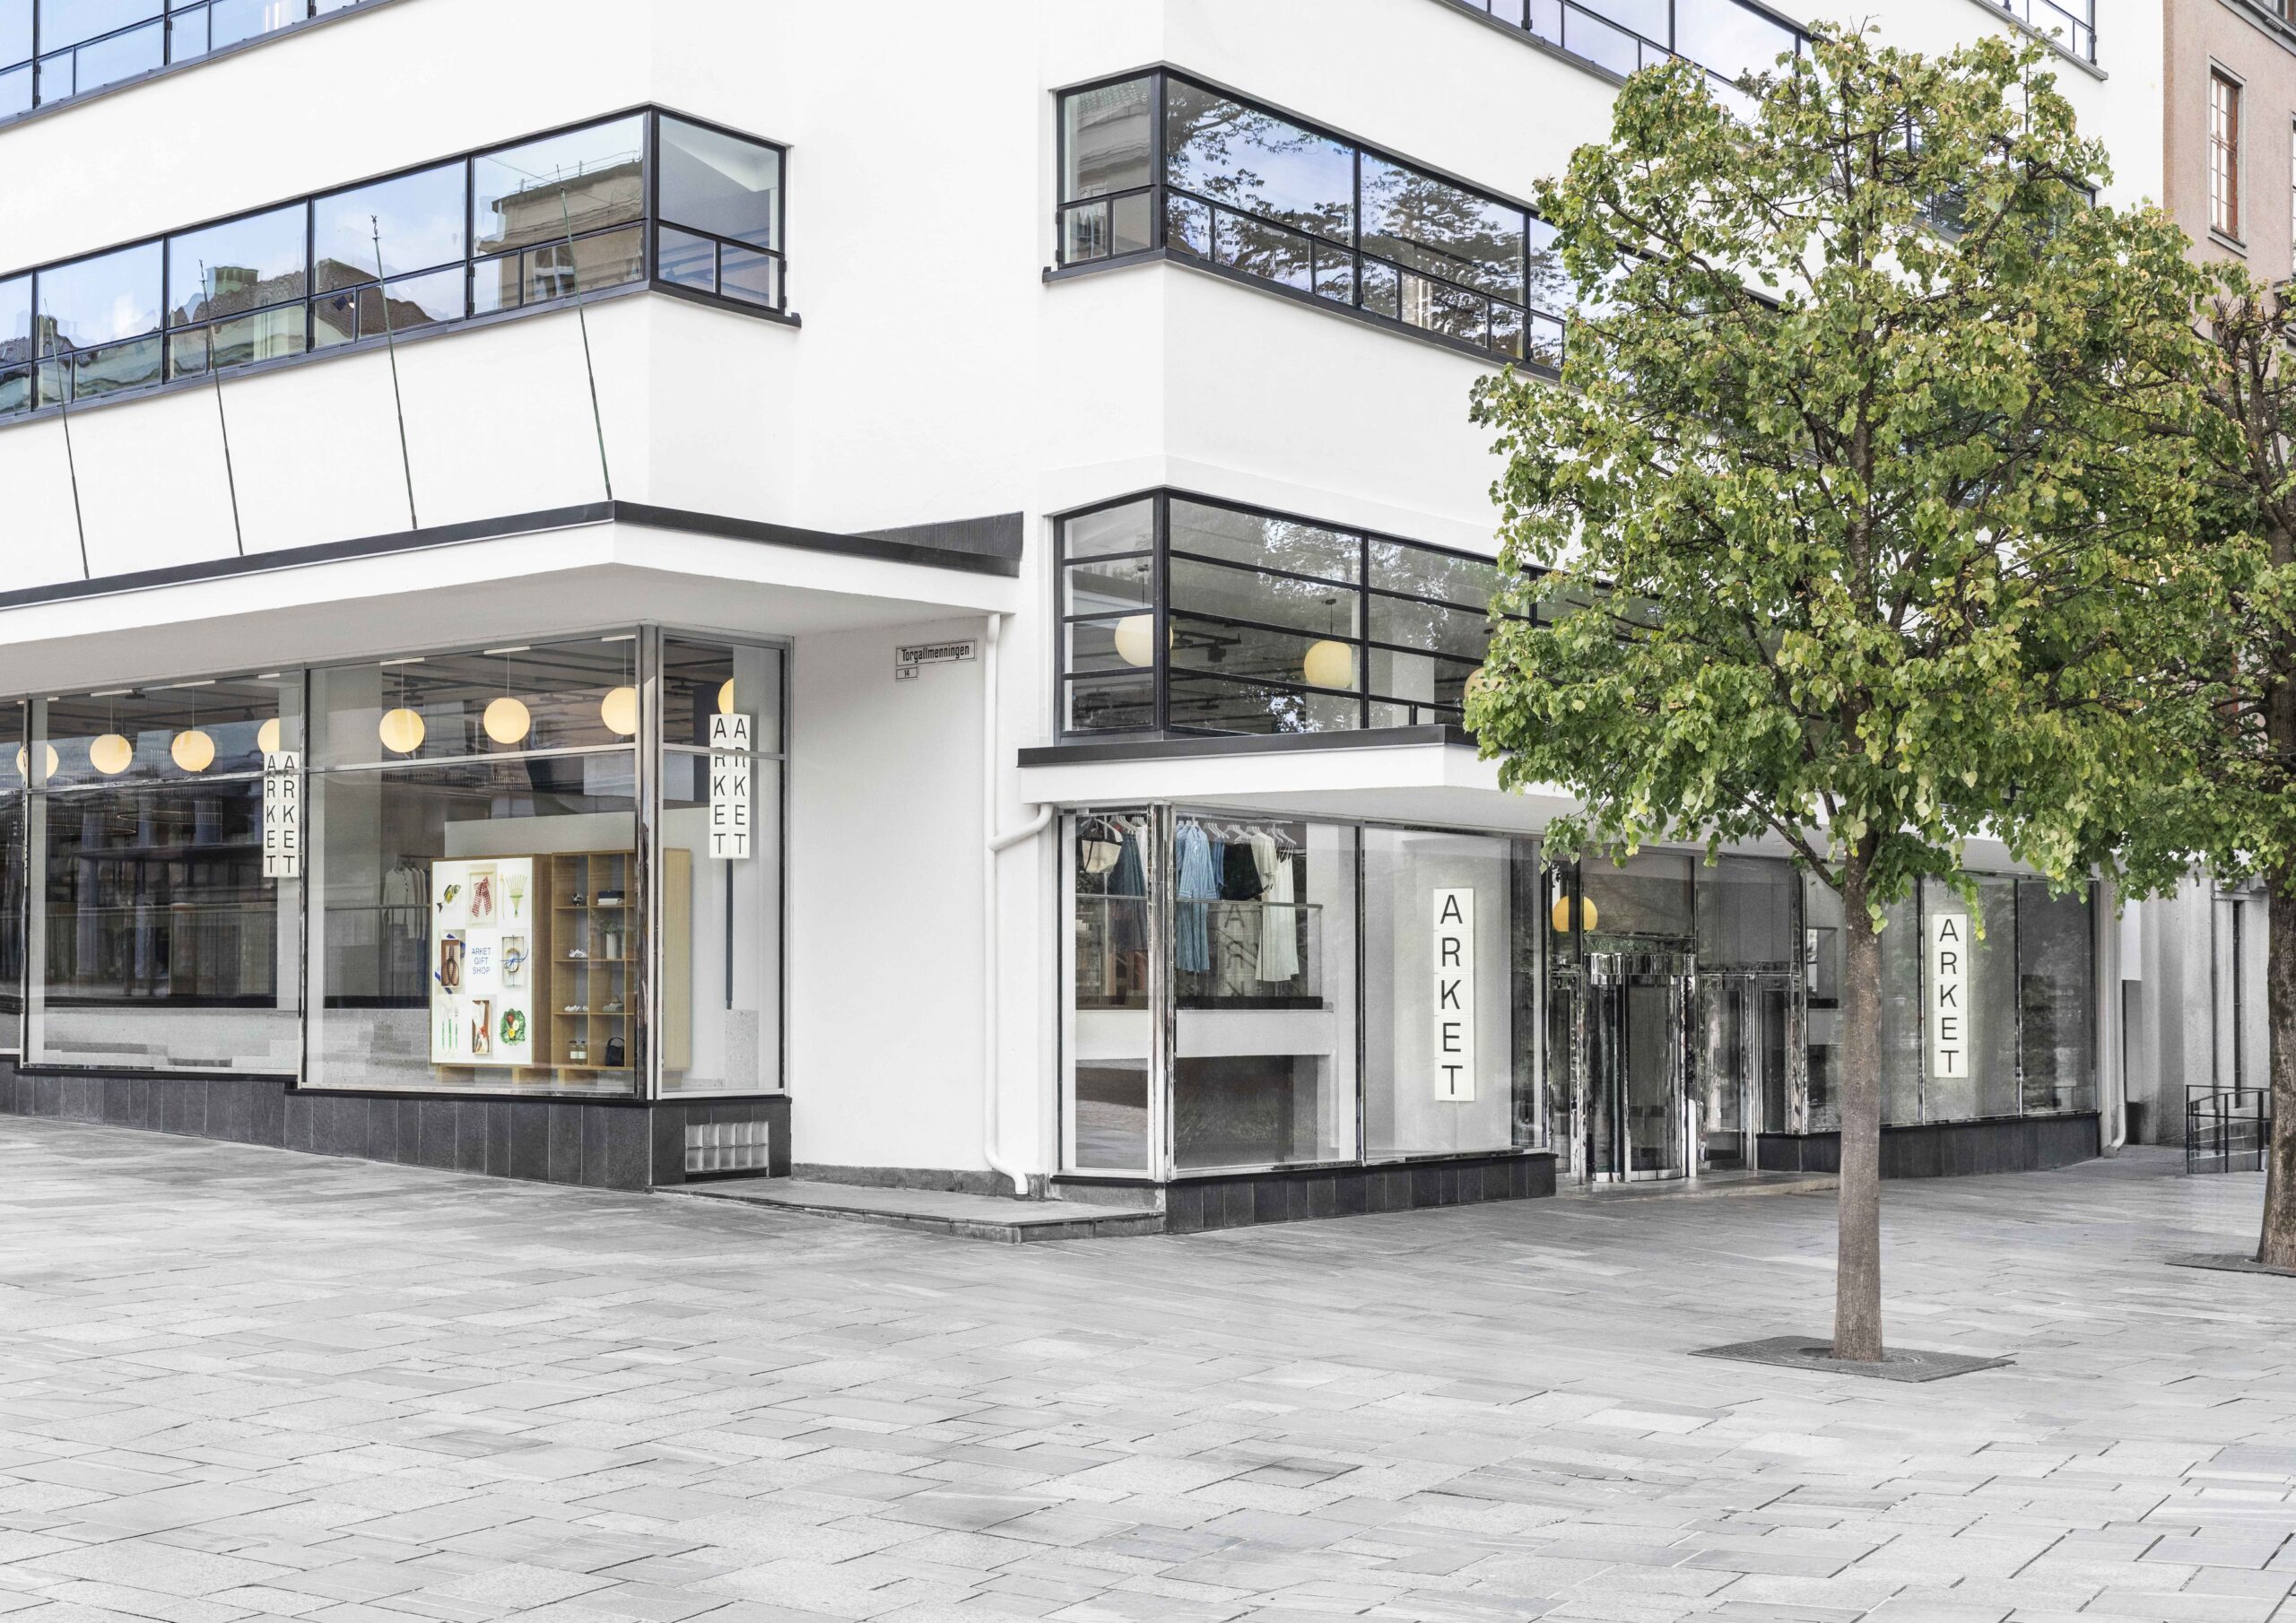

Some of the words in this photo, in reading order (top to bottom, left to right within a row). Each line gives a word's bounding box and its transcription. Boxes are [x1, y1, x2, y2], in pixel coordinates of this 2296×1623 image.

[901, 644, 970, 664] Torgallmenningen
[903, 669, 910, 678] 14
[266, 754, 276, 874] ARKET
[283, 754, 296, 874] ARKET
[713, 717, 727, 855] ARKET
[734, 717, 747, 855] ARKET
[472, 947, 491, 956] ARKET
[473, 967, 491, 975] SHOP
[474, 957, 488, 965] GIFT
[1439, 894, 1464, 1095] ARKET
[1939, 918, 1960, 1073] ARKET
